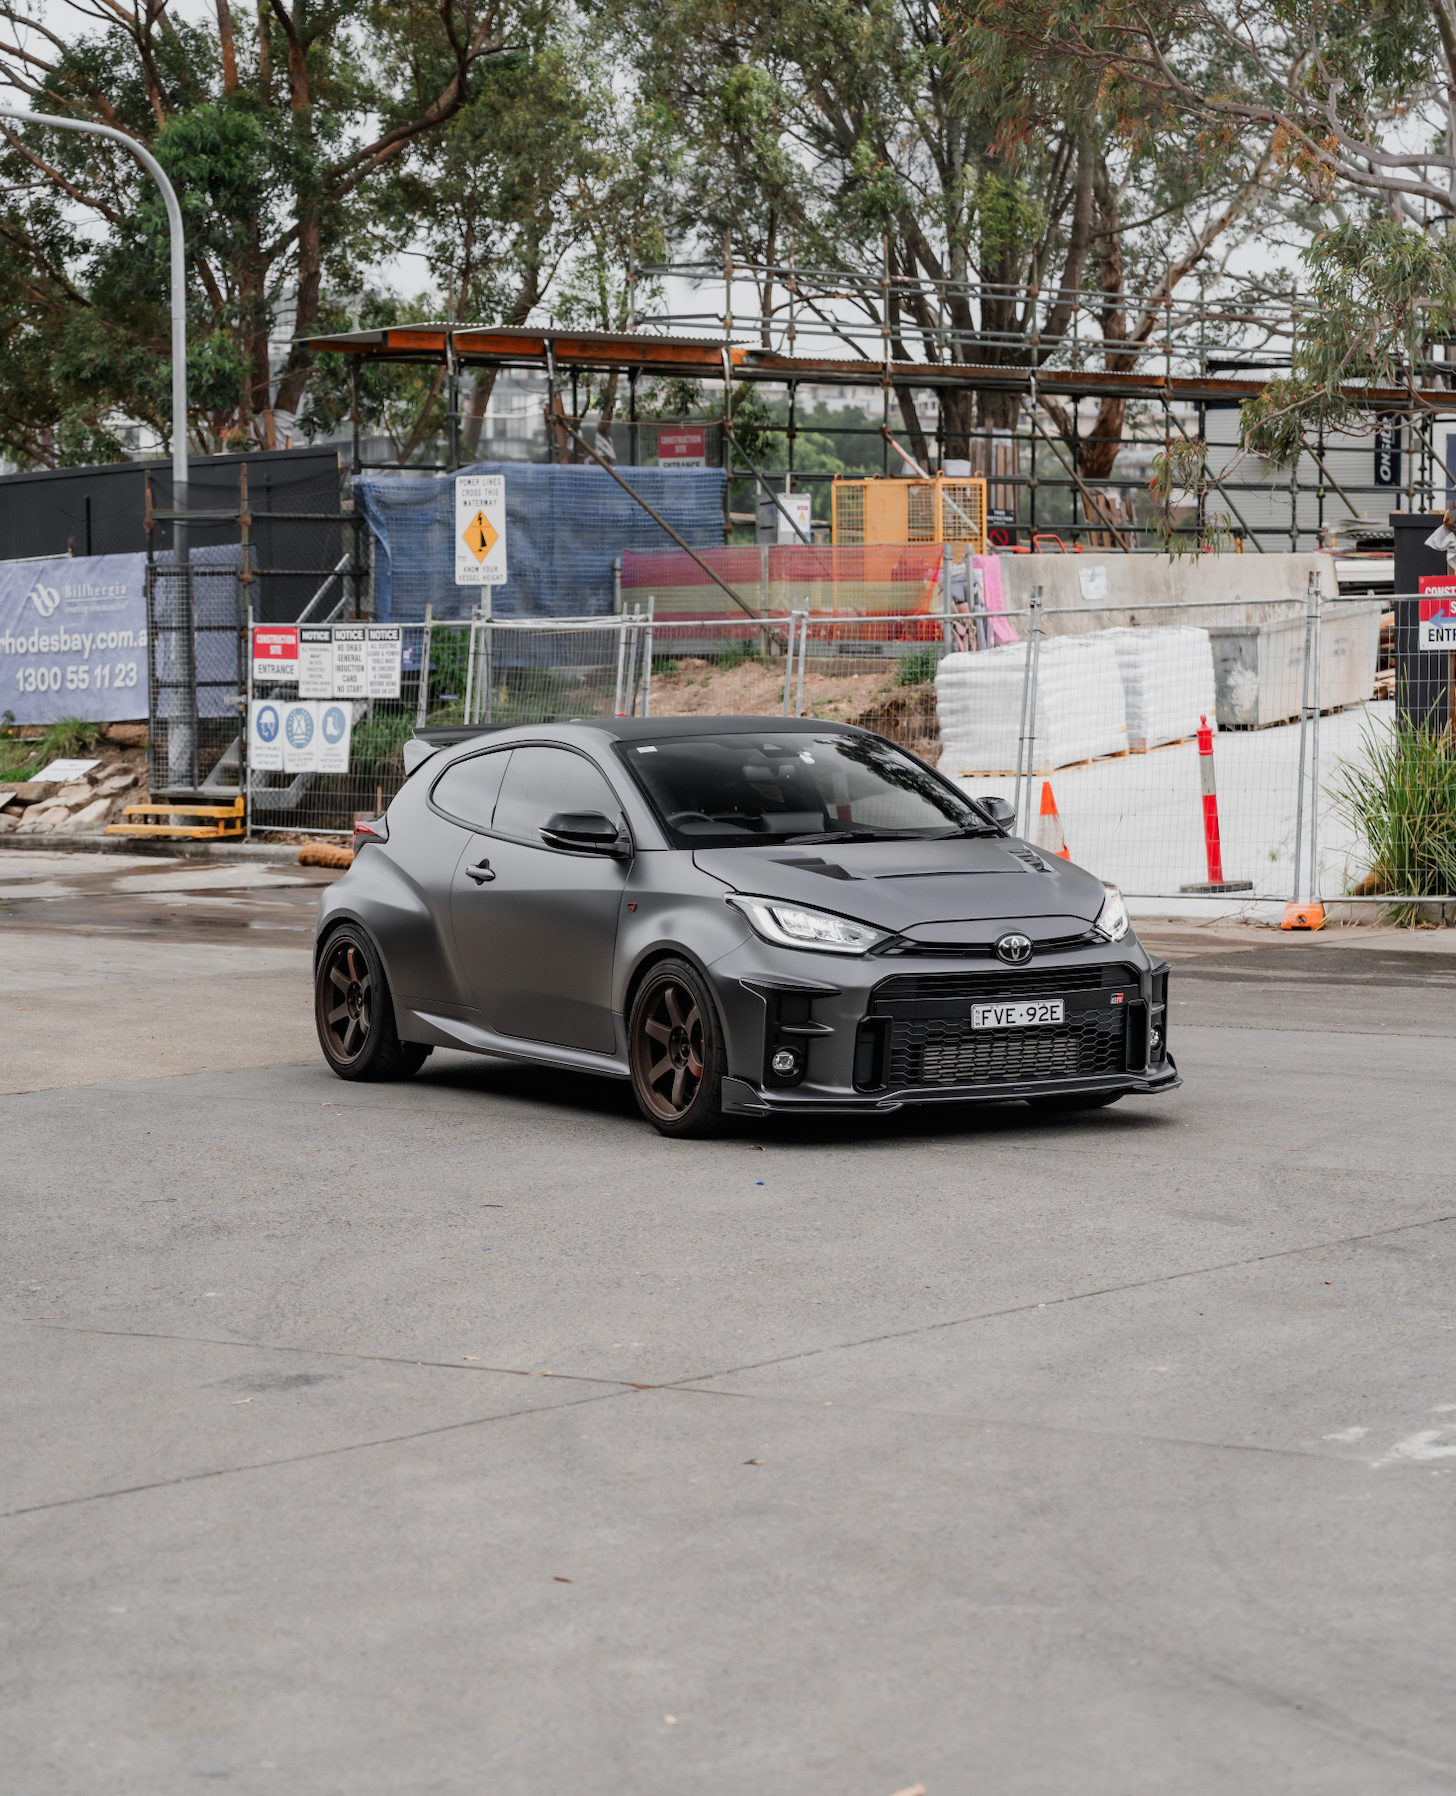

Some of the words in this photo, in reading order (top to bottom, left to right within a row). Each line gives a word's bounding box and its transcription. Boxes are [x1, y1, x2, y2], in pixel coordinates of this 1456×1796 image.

[661, 435, 702, 444] CONSTRUCTION
[675, 445, 687, 453] SITE
[65, 582, 127, 598] Billbergia
[256, 634, 296, 644] CONSTRUCTION
[302, 631, 330, 640] NOTICE
[335, 629, 364, 640] NOTICE
[369, 630, 399, 640] NOTICE
[0, 625, 158, 660] rhodesbay.com.a
[270, 645, 282, 655] SITE
[337, 654, 362, 662] GENERAL
[258, 664, 294, 674] ENTRANCE
[16, 667, 62, 692] 1300
[66, 665, 90, 690] 55
[94, 664, 111, 688] 11
[113, 662, 138, 688] 23
